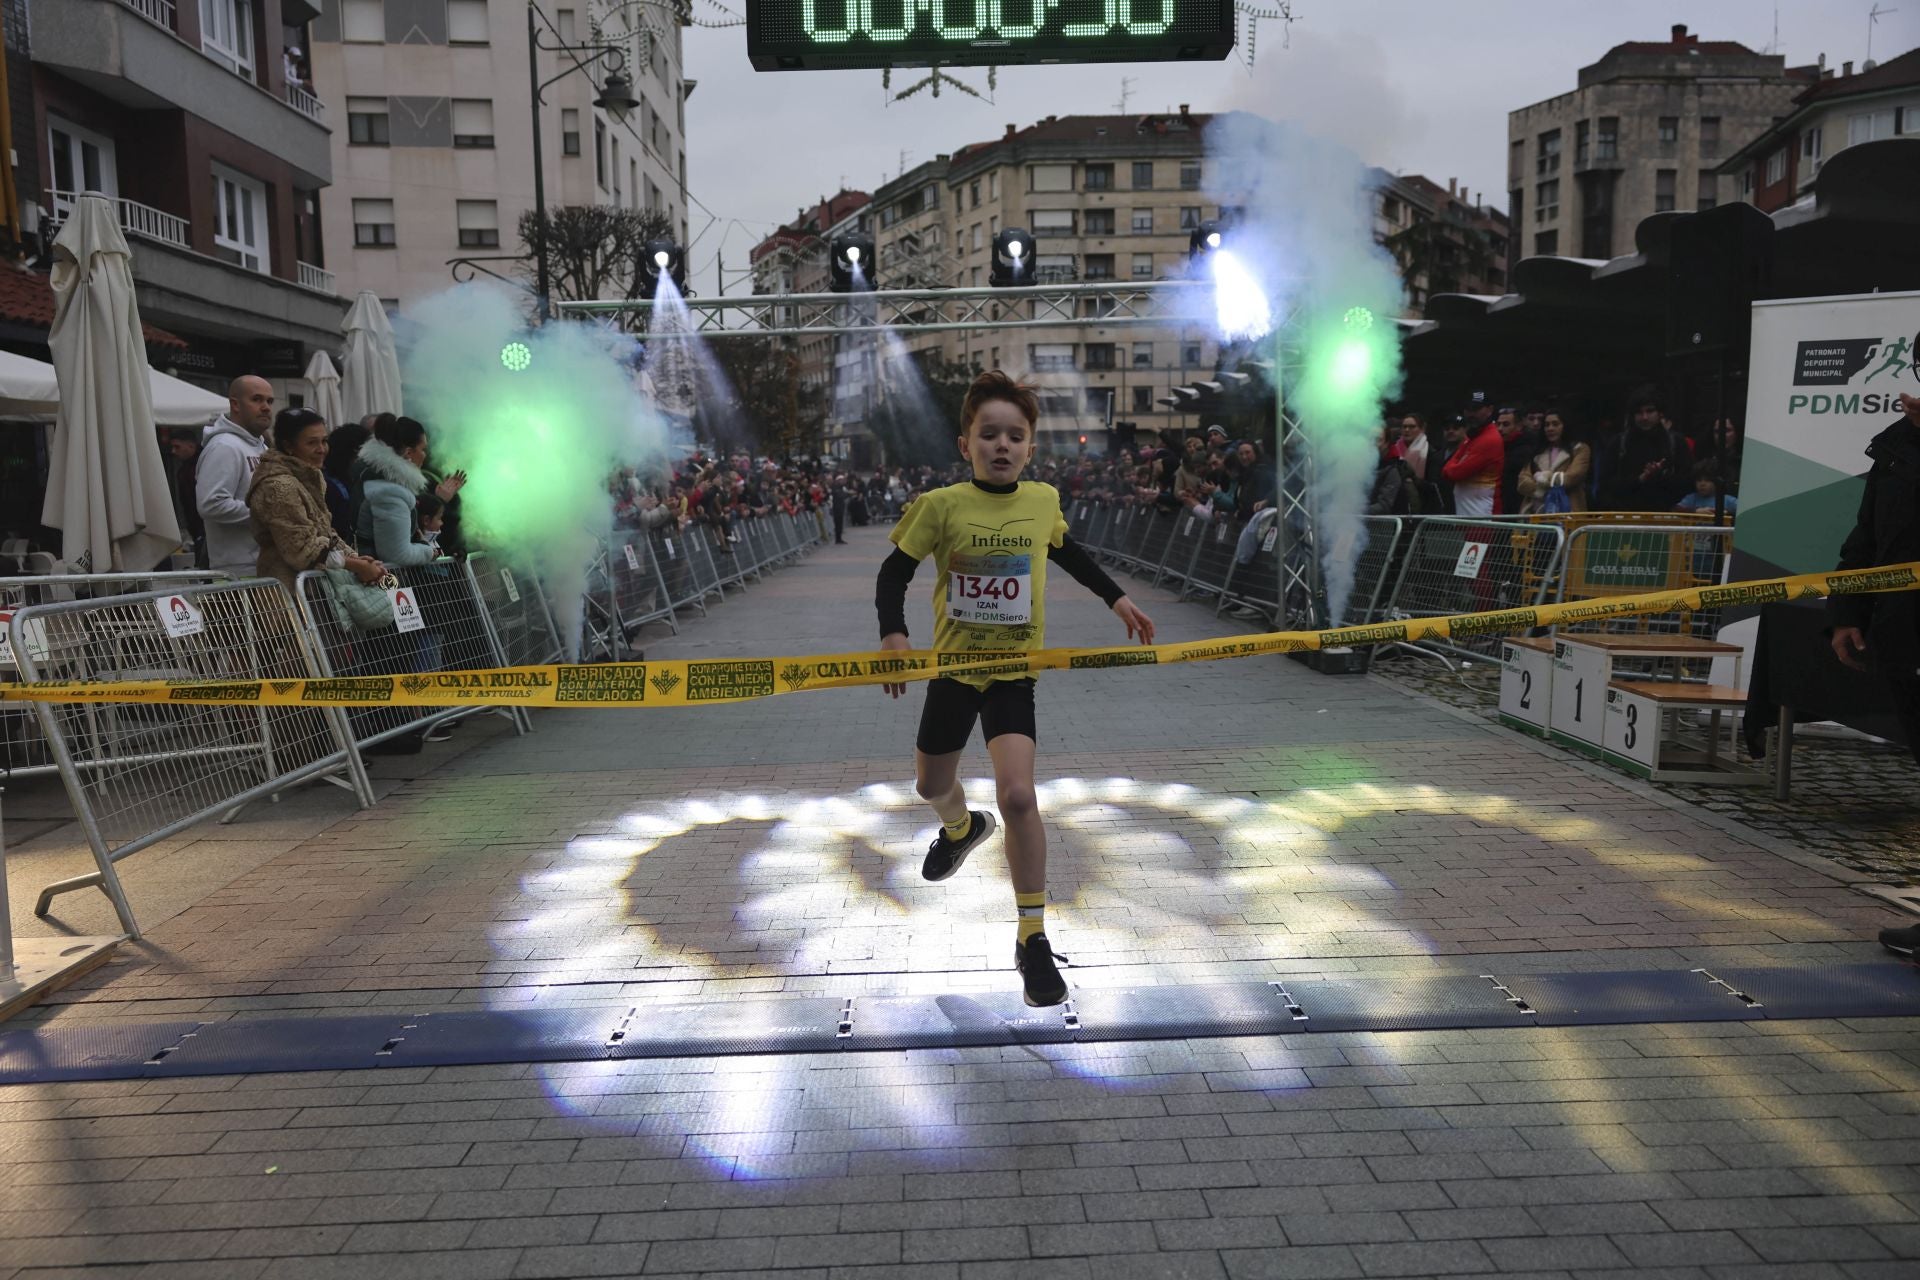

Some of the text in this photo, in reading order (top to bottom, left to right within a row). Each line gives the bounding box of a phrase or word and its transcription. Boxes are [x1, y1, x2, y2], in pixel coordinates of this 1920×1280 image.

[1805, 348, 1846, 356] PATRONATO
[1804, 359, 1845, 367] DEPORTIVO
[1788, 393, 1904, 415] PDMSie
[972, 534, 1032, 547] Infiesto
[1591, 565, 1660, 576] CAJA RURAL
[957, 575, 1019, 600] 1340
[1713, 584, 1783, 601] AMBIENTE
[976, 601, 998, 610] IZAN
[975, 612, 1023, 621] PDMSiero
[1464, 610, 1535, 629] RECICLADO
[1333, 626, 1405, 643] AMBIENTE
[1181, 643, 1237, 660] ASTURIAS
[1239, 643, 1255, 653] DE
[1086, 651, 1155, 665] RECICLADO
[560, 667, 645, 681] FABRICADO
[690, 662, 771, 674] COMPROMETIDOS
[817, 661, 863, 678] CAJA
[870, 658, 927, 675] RURAL
[308, 678, 392, 690] CON EL MEDIO
[437, 672, 553, 687] CAJA RURAL
[560, 680, 644, 690] CON MATERIAL
[690, 672, 772, 686] CON EL MEDIO
[172, 689, 244, 699] RECICLADO
[305, 690, 379, 700] AMBIENTE
[456, 690, 473, 698] DE
[475, 690, 532, 698] ASTURIAS
[558, 690, 629, 700] RECICLADO
[689, 686, 761, 699] AMBIENTE
[1520, 670, 1531, 710] 2
[1574, 677, 1583, 723] 1
[1624, 703, 1638, 749] 3
